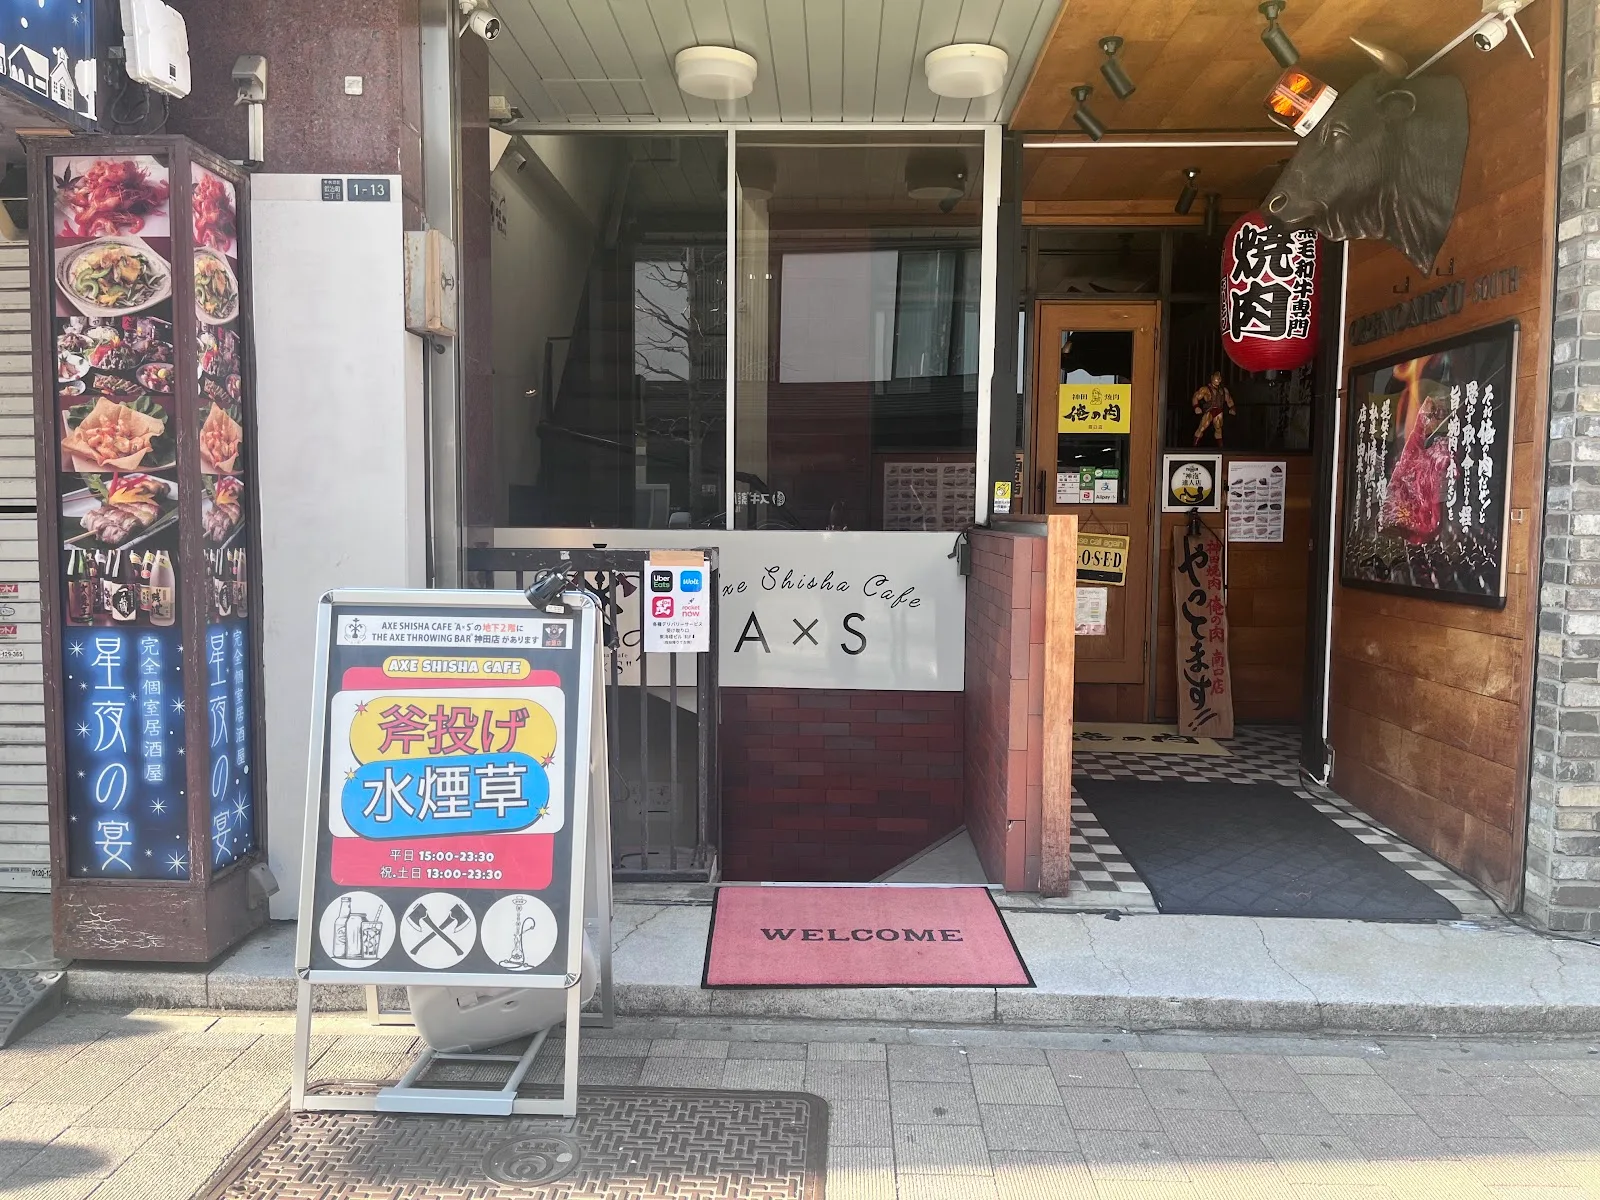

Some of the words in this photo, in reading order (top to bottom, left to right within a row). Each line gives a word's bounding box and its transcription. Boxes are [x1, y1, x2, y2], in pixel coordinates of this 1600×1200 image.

[353, 184, 385, 196] 1-13
[1231, 223, 1293, 341] 焼肉
[1472, 265, 1520, 304] SOUTH
[1063, 403, 1121, 422] 俺の肉
[1090, 538, 1102, 546] call
[1104, 540, 1124, 548] again
[722, 579, 748, 597] xe
[761, 566, 850, 591] Shisha
[863, 574, 921, 609] Cafe
[372, 633, 388, 641] THE
[389, 633, 405, 642] AXE
[407, 634, 453, 642] THROWING
[474, 635, 501, 644] 神田店
[502, 636, 540, 644] があります
[381, 622, 398, 630] AXE
[399, 622, 430, 631] SHISHA
[431, 623, 452, 631] CAFE
[733, 611, 771, 653] A
[840, 612, 867, 656] S
[1206, 595, 1225, 643] 俺の肉
[388, 659, 419, 672] AXE
[422, 660, 479, 673] SHISHA
[482, 660, 521, 674] CAFE
[1210, 649, 1225, 696] 南口店
[140, 636, 164, 783] 完全個室居酒屋
[233, 629, 246, 766] 完全個室居酒屋
[208, 633, 232, 864] 星夜の宴
[377, 703, 530, 755] 斧投げ
[91, 637, 133, 871] 星夜の宴
[362, 761, 529, 823] 水煙草
[390, 849, 414, 861] 平日
[419, 850, 495, 862] 15:00-23:30
[426, 868, 503, 880] 13:00-23:30
[760, 928, 964, 942] WELCOME
